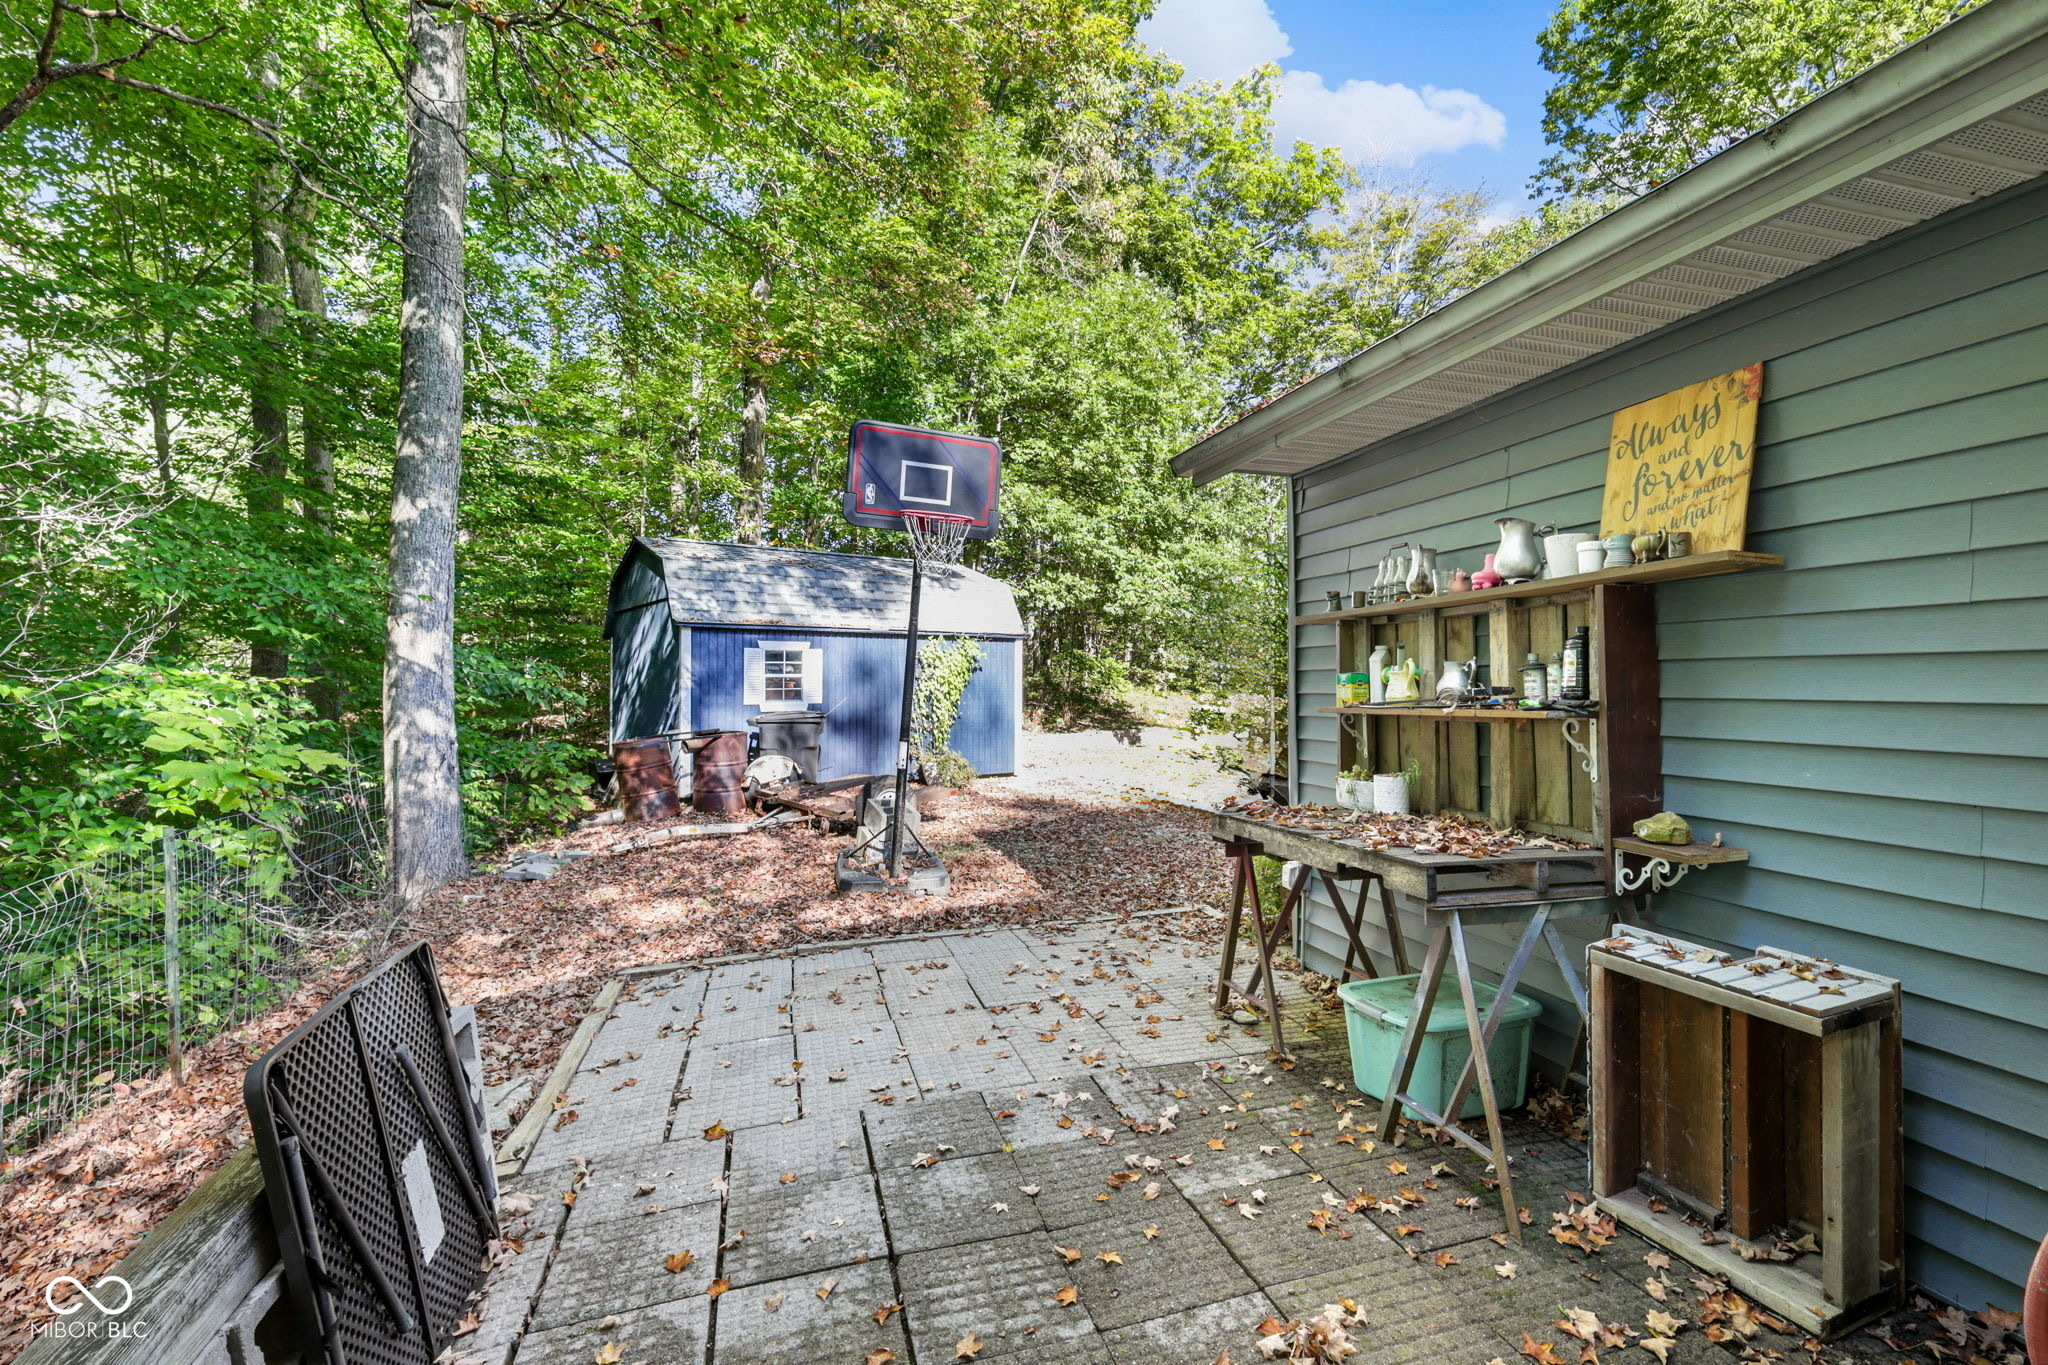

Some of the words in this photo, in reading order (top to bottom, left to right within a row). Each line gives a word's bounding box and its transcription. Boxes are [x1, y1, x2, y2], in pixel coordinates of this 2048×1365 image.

[1615, 392, 1721, 460] Always
[1658, 435, 1692, 465] and
[1623, 440, 1756, 522] forever
[1647, 495, 1672, 515] and
[1673, 493, 1689, 506] no
[1692, 475, 1735, 498] matter
[1670, 495, 1719, 529] what
